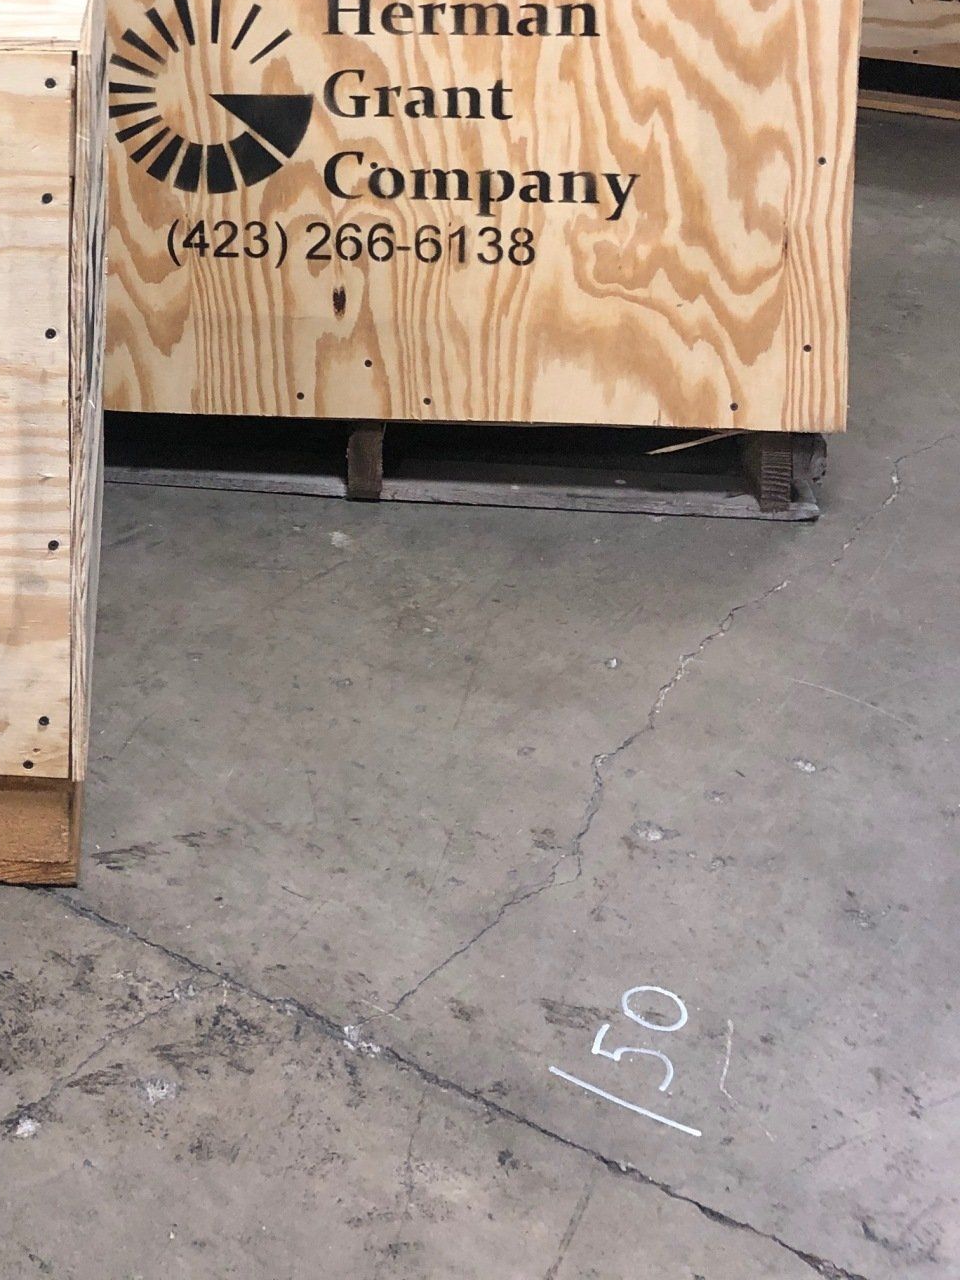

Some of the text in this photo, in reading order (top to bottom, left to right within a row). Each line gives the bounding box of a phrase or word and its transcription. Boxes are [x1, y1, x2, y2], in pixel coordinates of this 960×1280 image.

[324, 69, 514, 121] Grant
[324, 151, 640, 221] Company
[168, 219, 536, 268] (423) 266-6138
[549, 985, 702, 1137] 150
